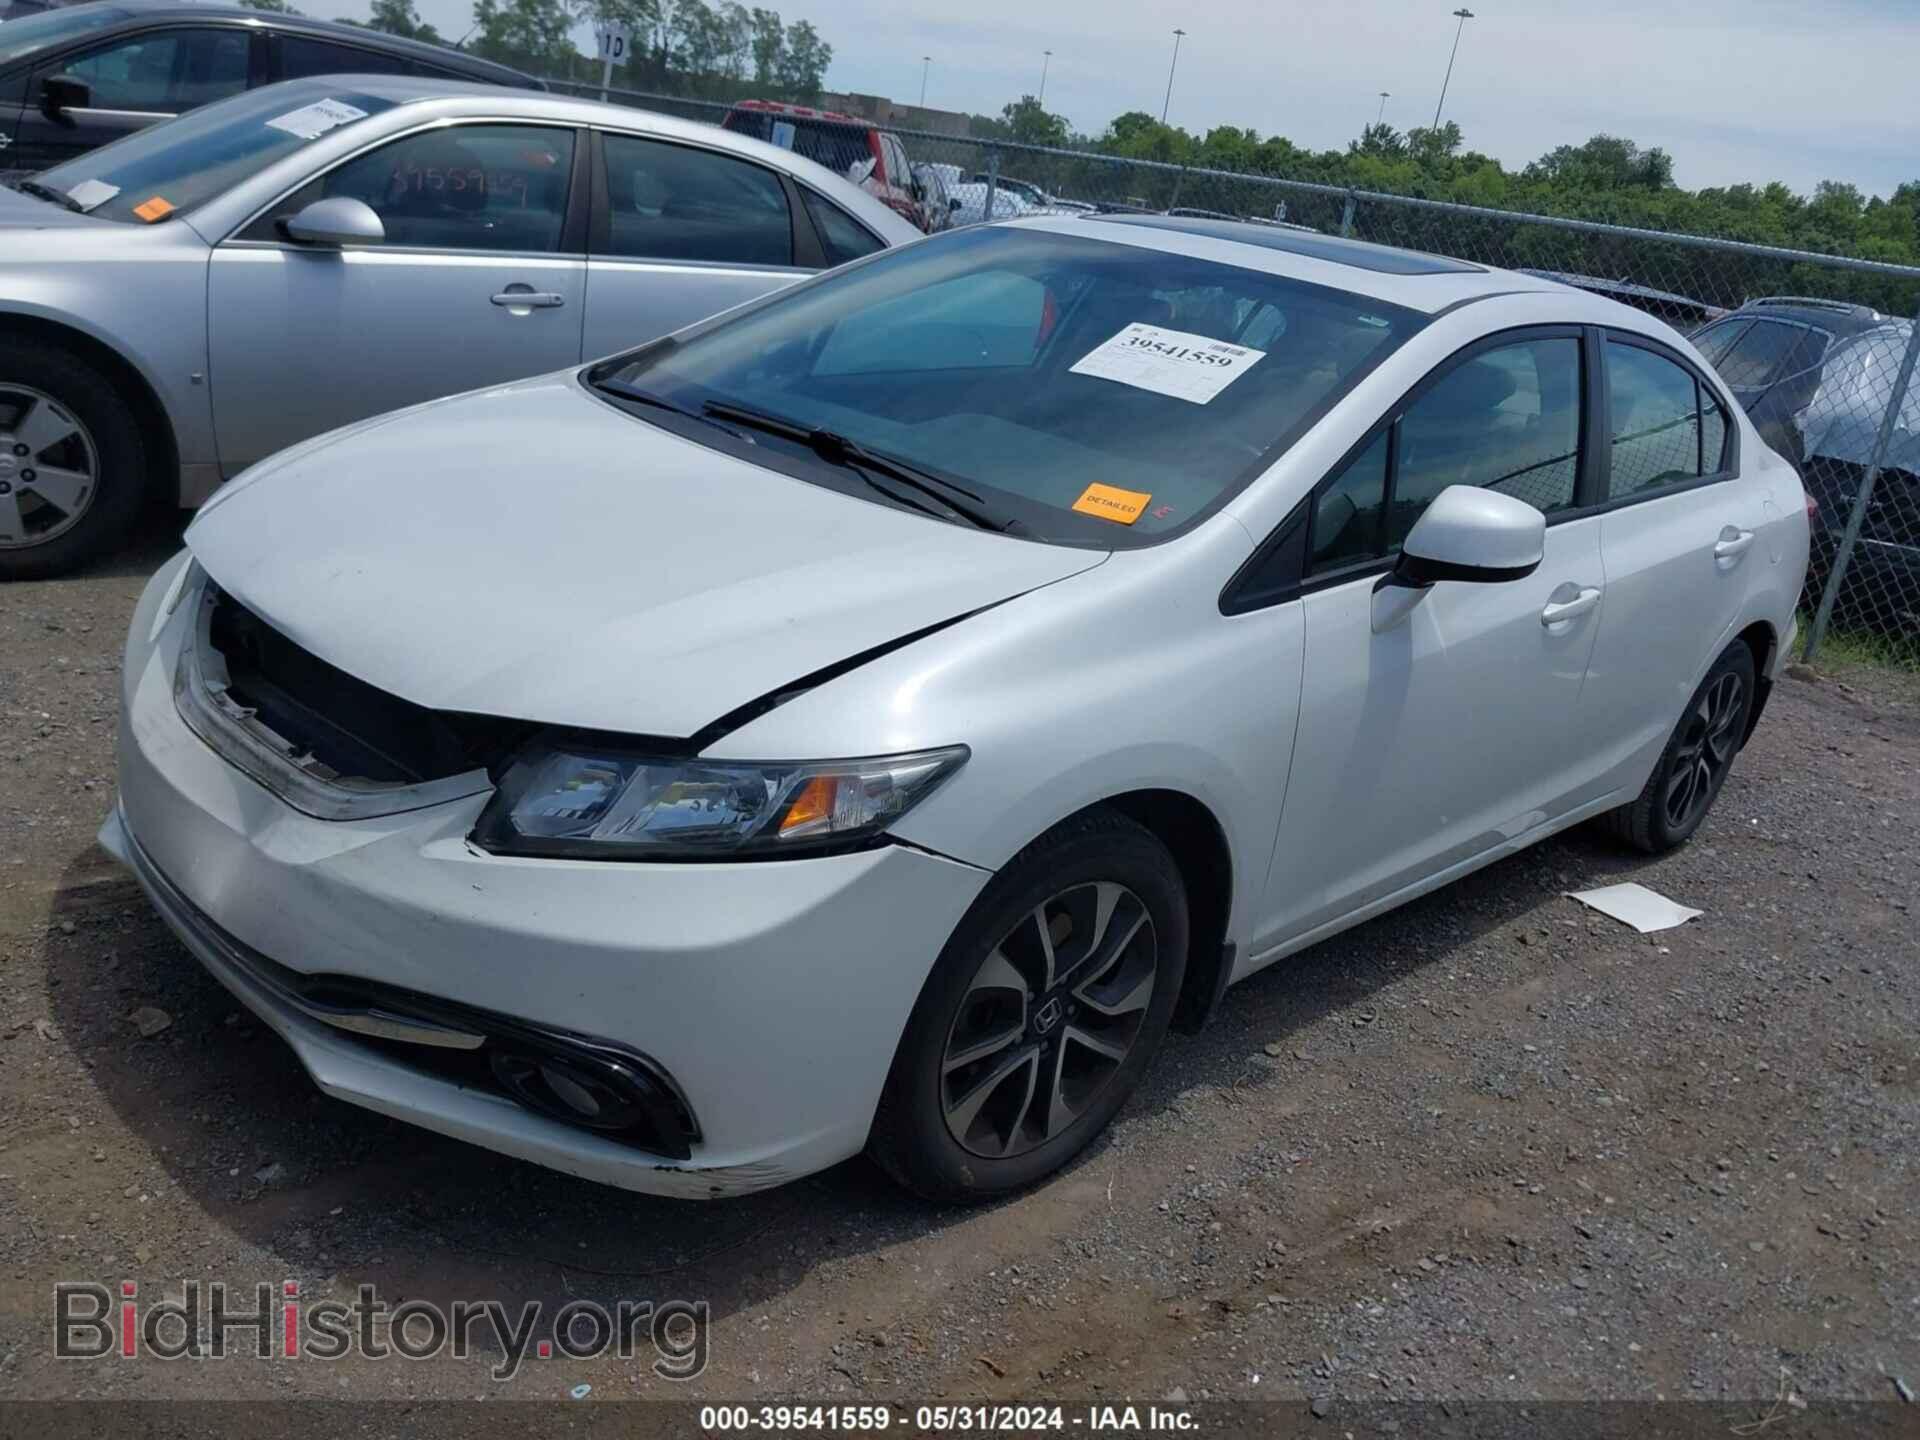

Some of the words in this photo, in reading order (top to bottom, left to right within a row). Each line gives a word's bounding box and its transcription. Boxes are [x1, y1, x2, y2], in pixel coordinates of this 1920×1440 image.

[605, 33, 624, 58] 1D
[1120, 336, 1233, 368] 39541559
[1086, 494, 1137, 514] DETAILED
